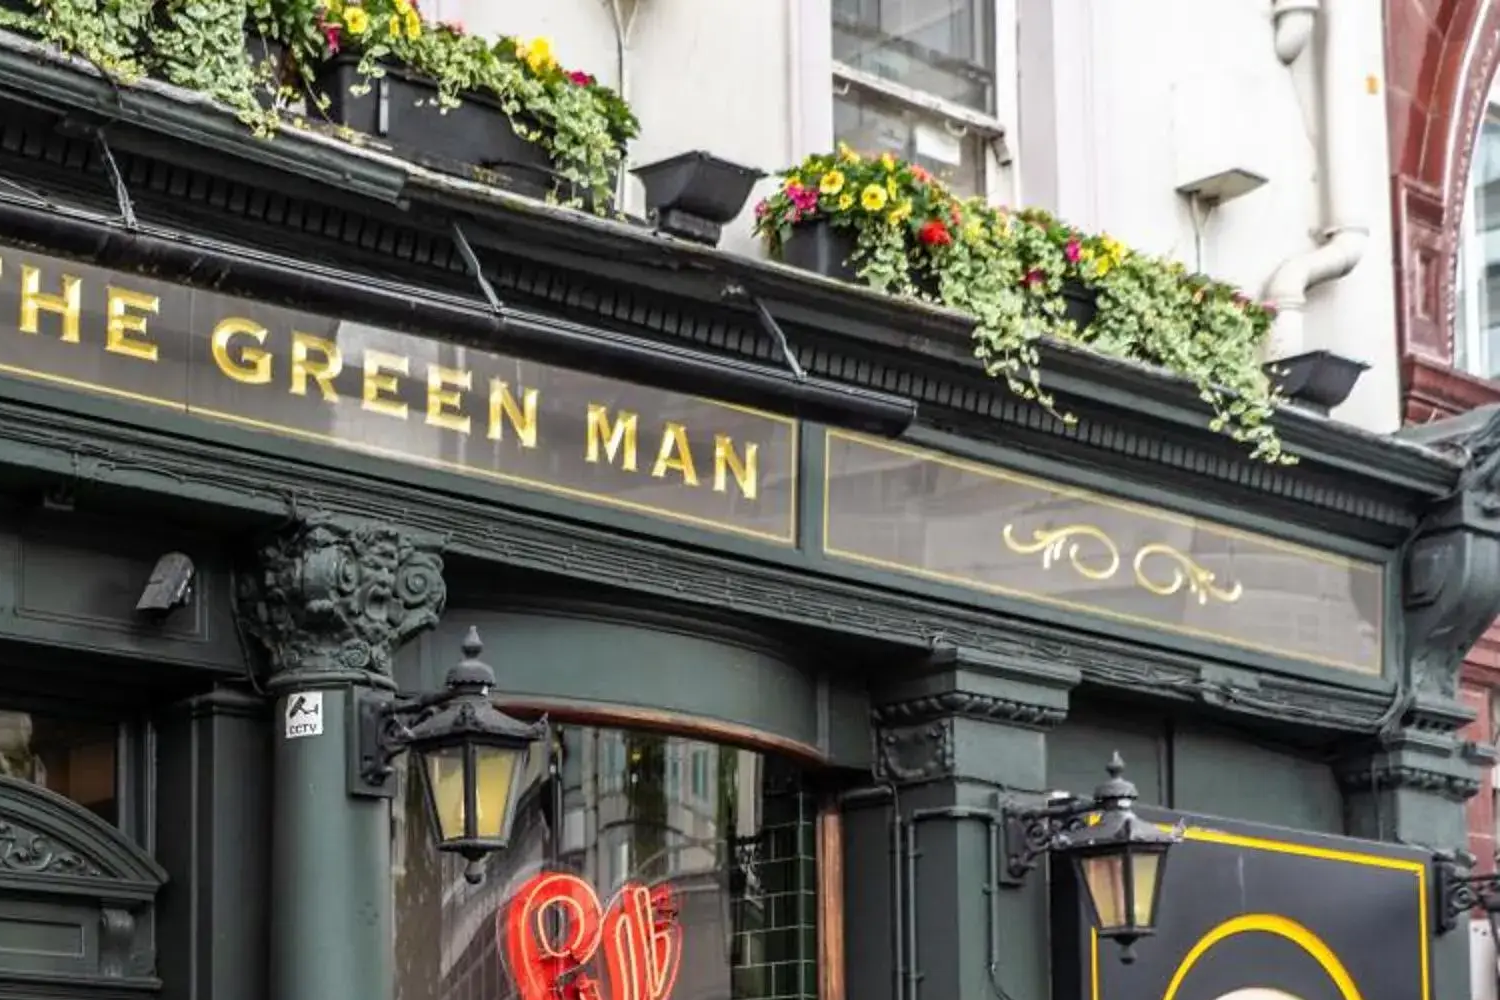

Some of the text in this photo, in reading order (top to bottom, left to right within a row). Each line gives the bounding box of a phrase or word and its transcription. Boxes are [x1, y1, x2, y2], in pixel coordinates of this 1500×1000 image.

[212, 317, 538, 447] GREEN
[586, 404, 758, 499] MAN
[290, 724, 317, 734] CCTV
